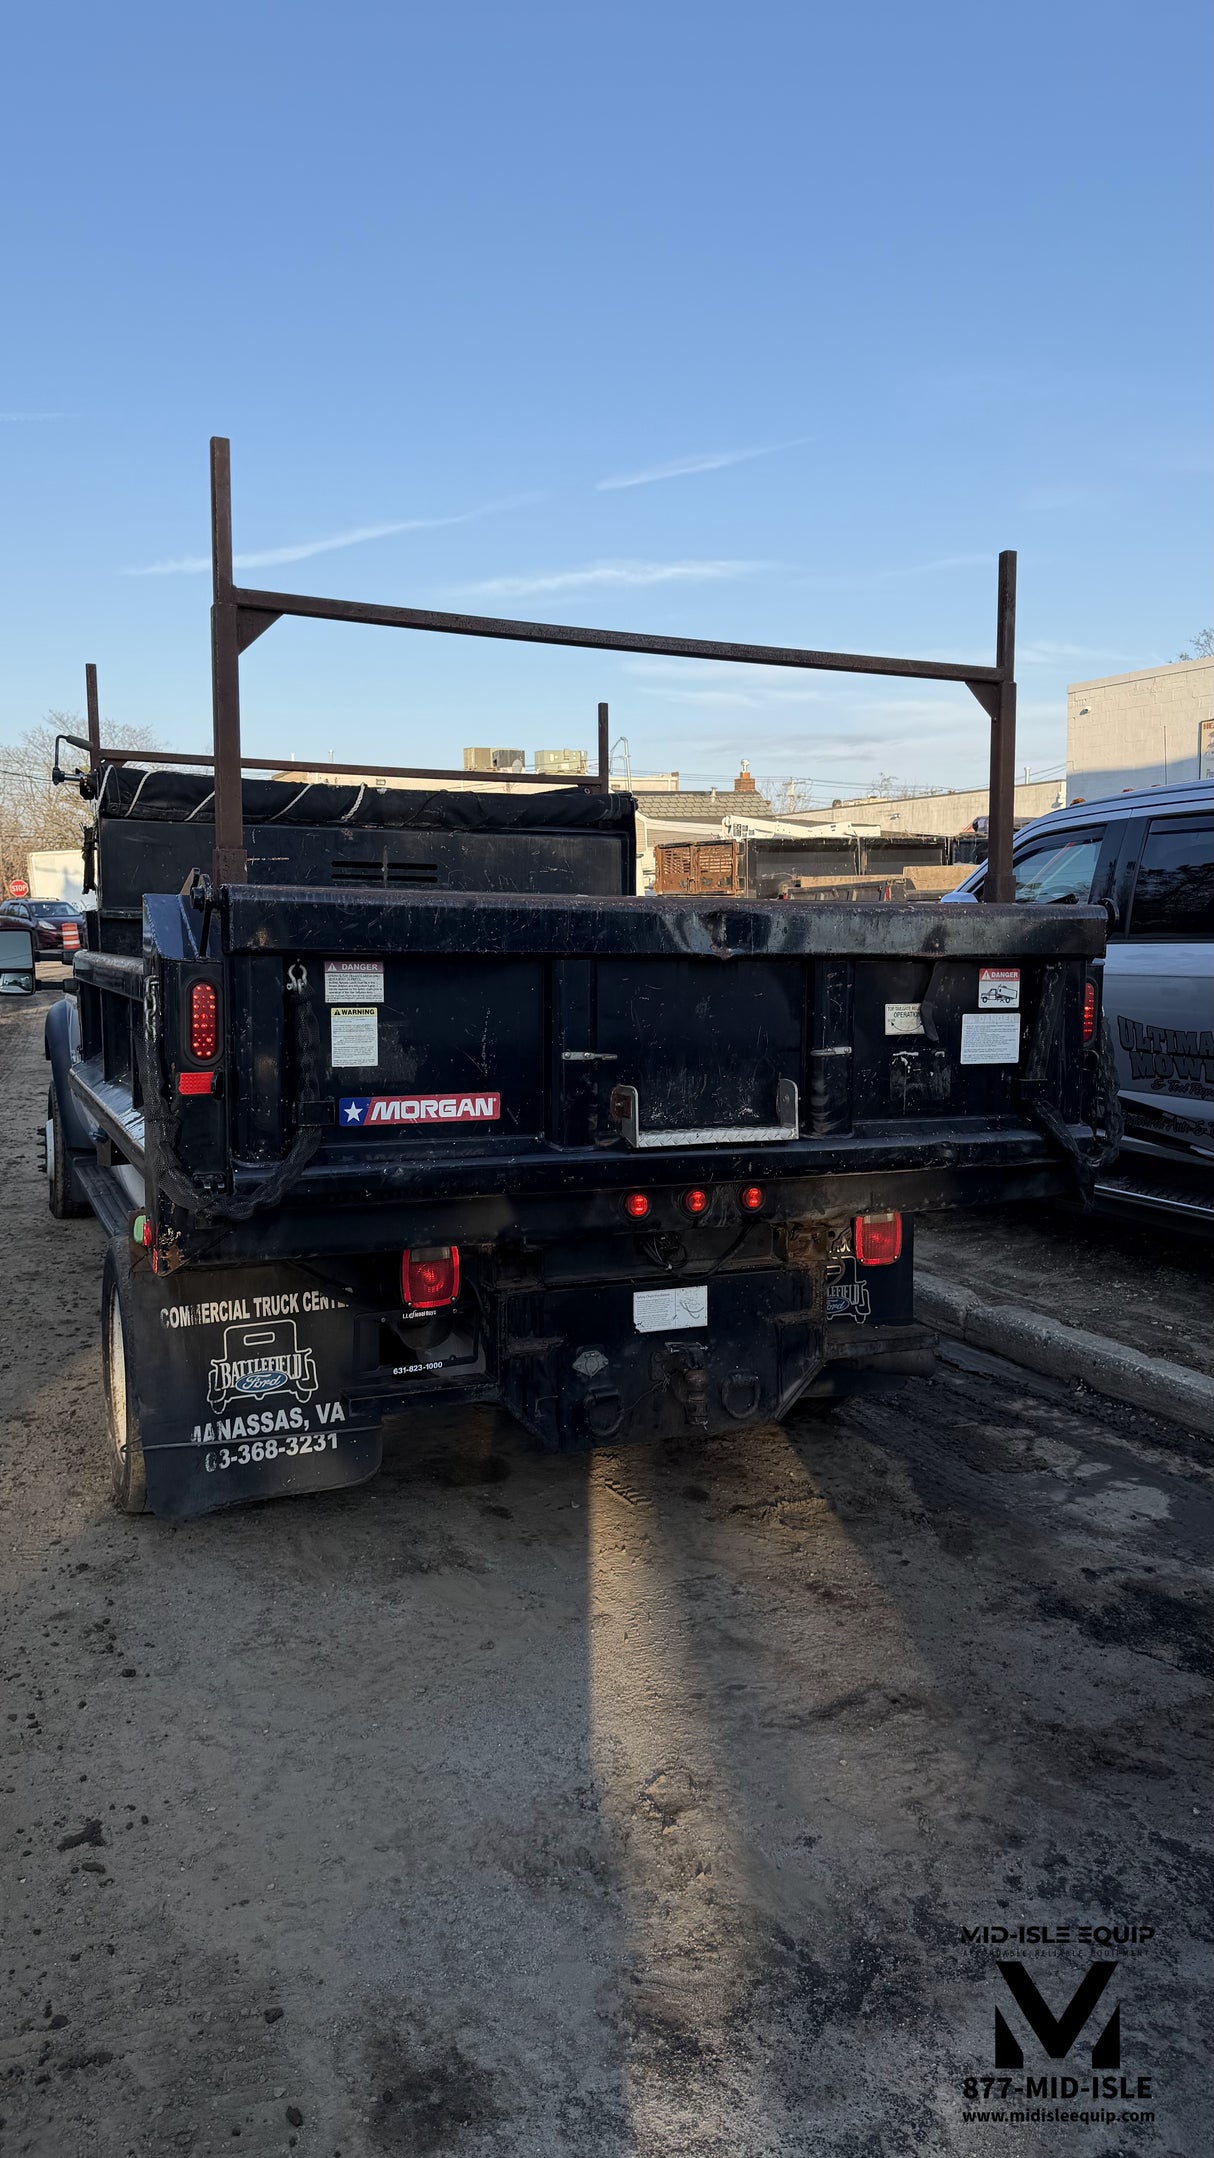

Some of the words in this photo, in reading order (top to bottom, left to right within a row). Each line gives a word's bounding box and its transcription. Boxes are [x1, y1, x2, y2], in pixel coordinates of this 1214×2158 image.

[1203, 721, 1214, 731] HE
[11, 883, 27, 893] STOP
[341, 963, 379, 971] DANGER
[991, 971, 1019, 979] DANGER
[341, 1008, 375, 1016] WARNING
[978, 1015, 1015, 1023] DANGER
[370, 1096, 495, 1121] MORGAN
[160, 1298, 251, 1329] COMMERCIAL
[253, 1292, 300, 1318] TRUCK
[302, 1287, 354, 1312] CEN
[219, 1353, 303, 1391] BATTLEFIELD
[392, 1361, 443, 1376] 631-823-1000
[242, 1373, 283, 1391] Ford
[316, 1401, 346, 1424] VA
